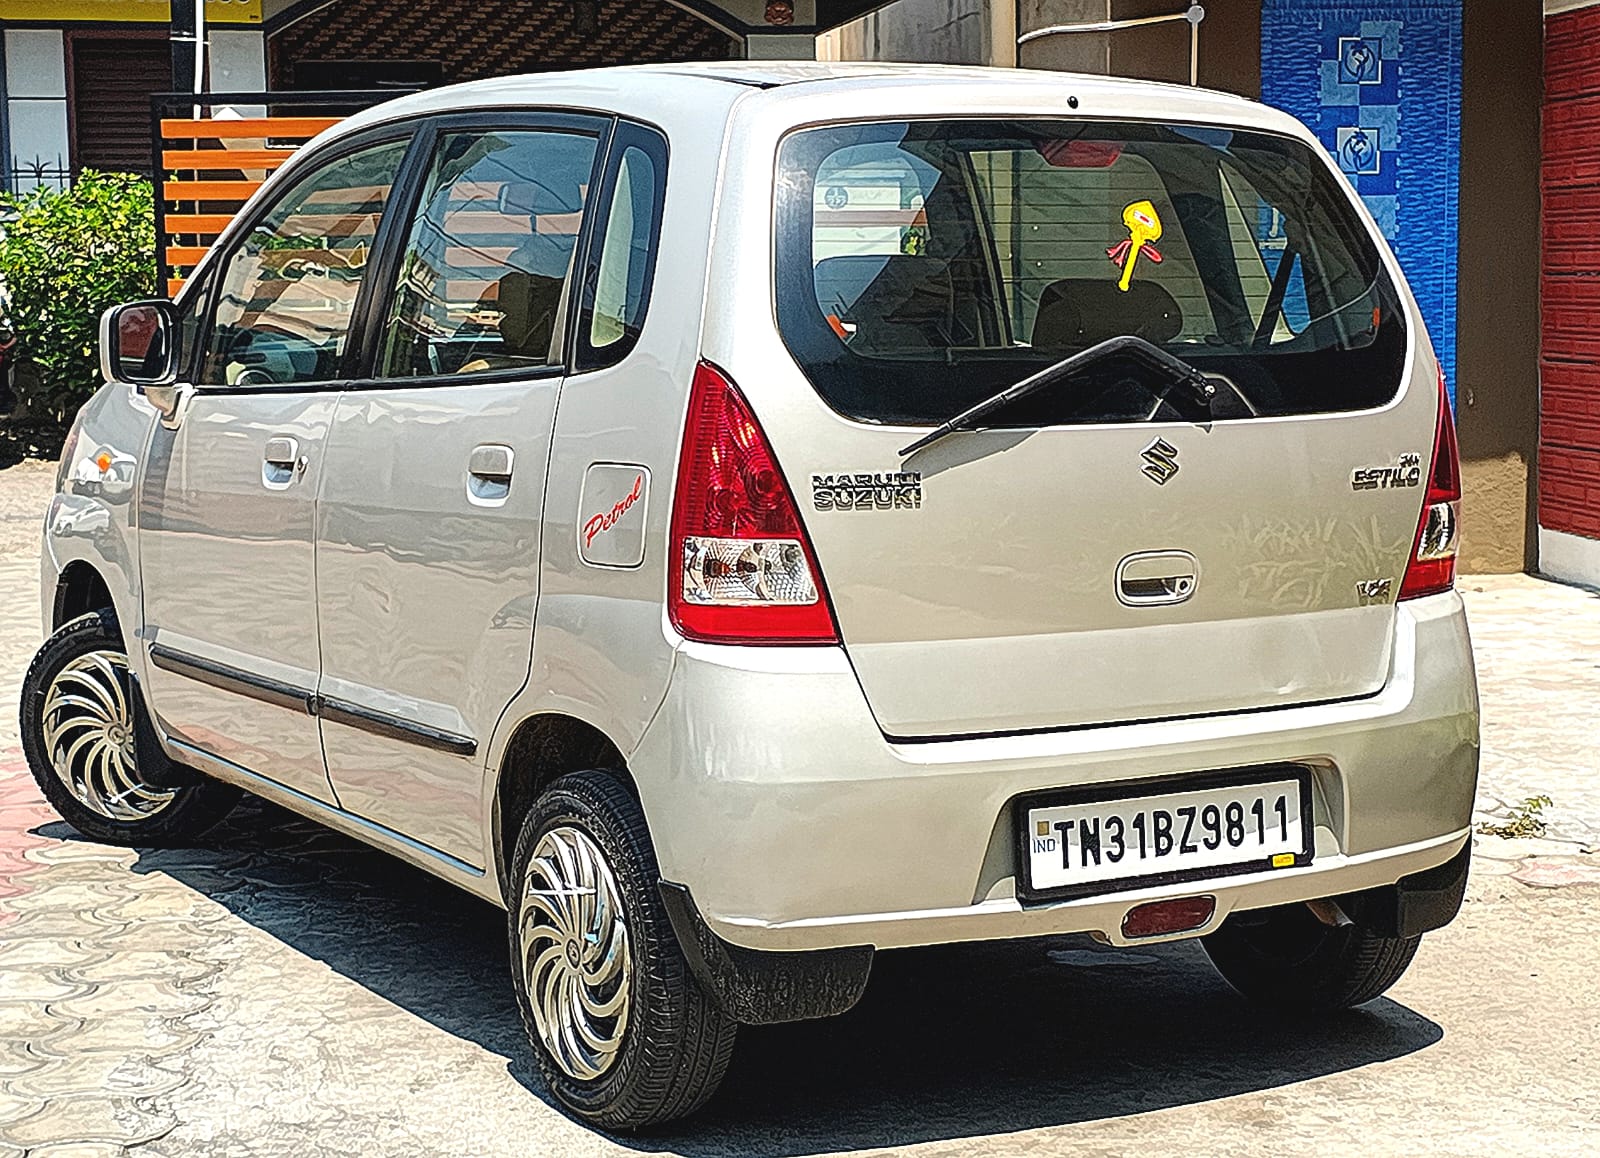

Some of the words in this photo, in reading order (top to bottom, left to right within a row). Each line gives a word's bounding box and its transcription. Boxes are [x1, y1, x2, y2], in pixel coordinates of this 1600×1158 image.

[812, 472, 922, 487] MARUTI
[1352, 467, 1420, 490] ESTILO
[813, 486, 922, 511] SUZUKI
[583, 474, 642, 549] Petrol
[1054, 795, 1288, 869] TN31BZ9811
[1033, 838, 1056, 853] IND
